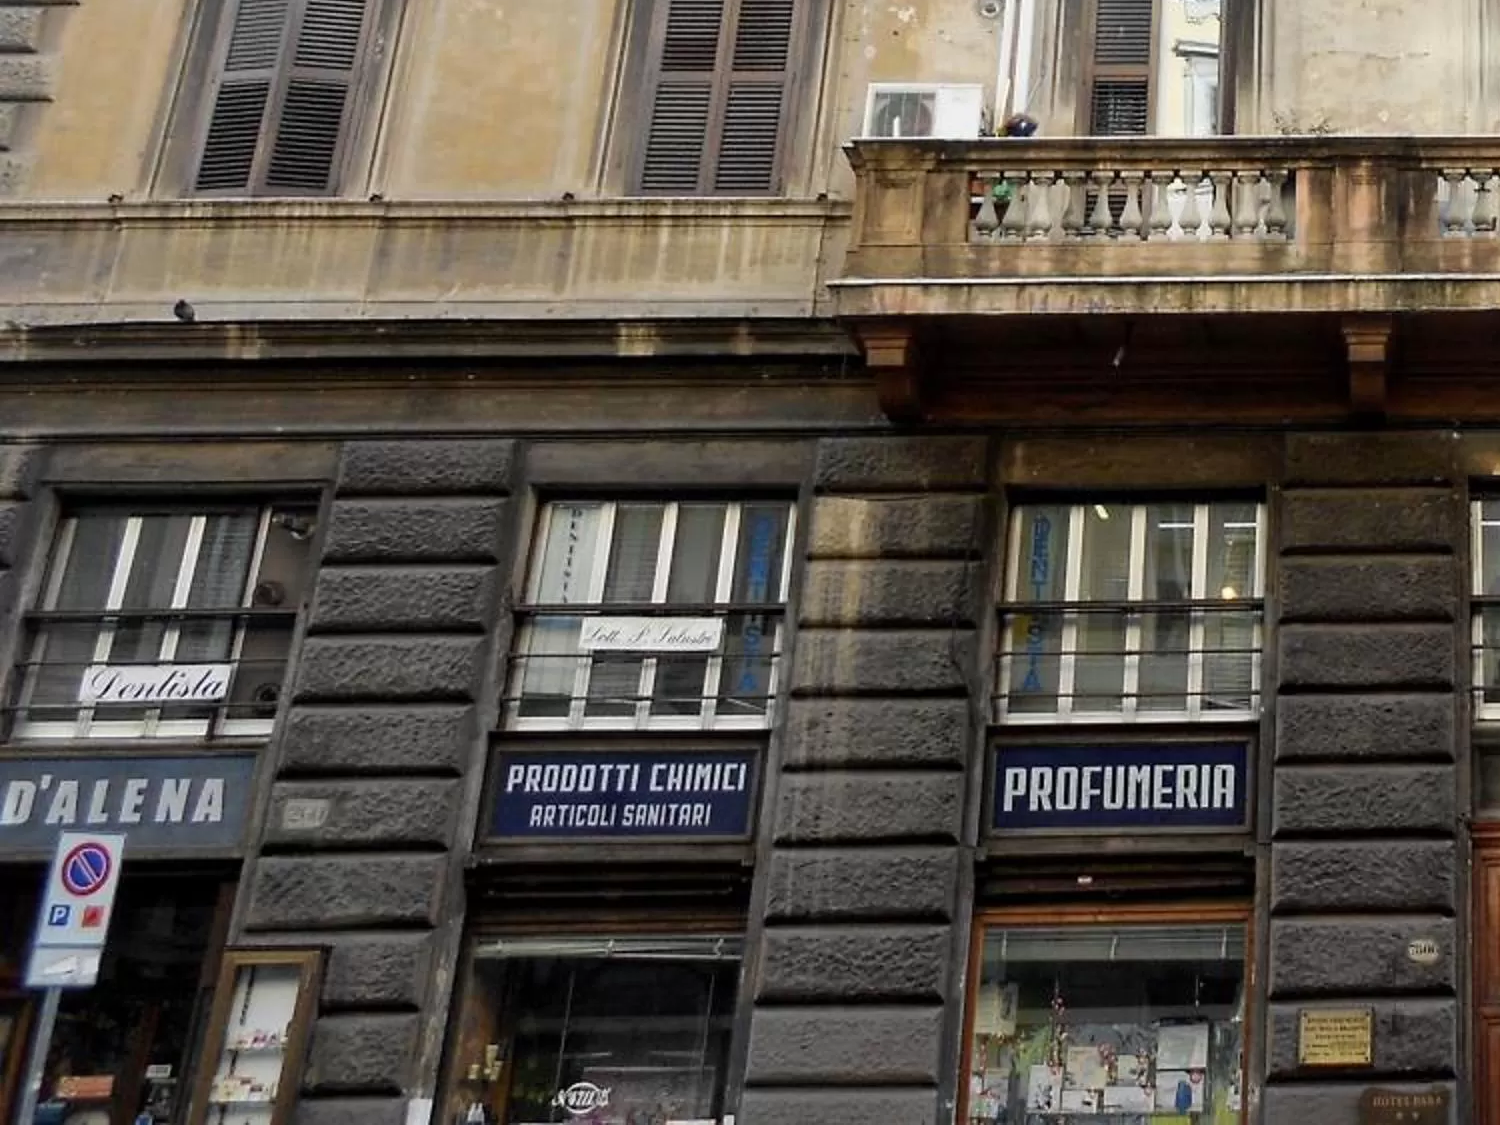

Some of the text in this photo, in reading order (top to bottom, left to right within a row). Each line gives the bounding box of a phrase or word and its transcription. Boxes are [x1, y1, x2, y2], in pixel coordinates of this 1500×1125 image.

[90, 667, 224, 699] Dentista
[505, 762, 748, 793] PRODOTTI CHIMICI
[1003, 764, 1236, 812] PROFUMERIA
[0, 774, 226, 825] D'ALENA
[529, 802, 712, 827] ARTICOLI SANITARI
